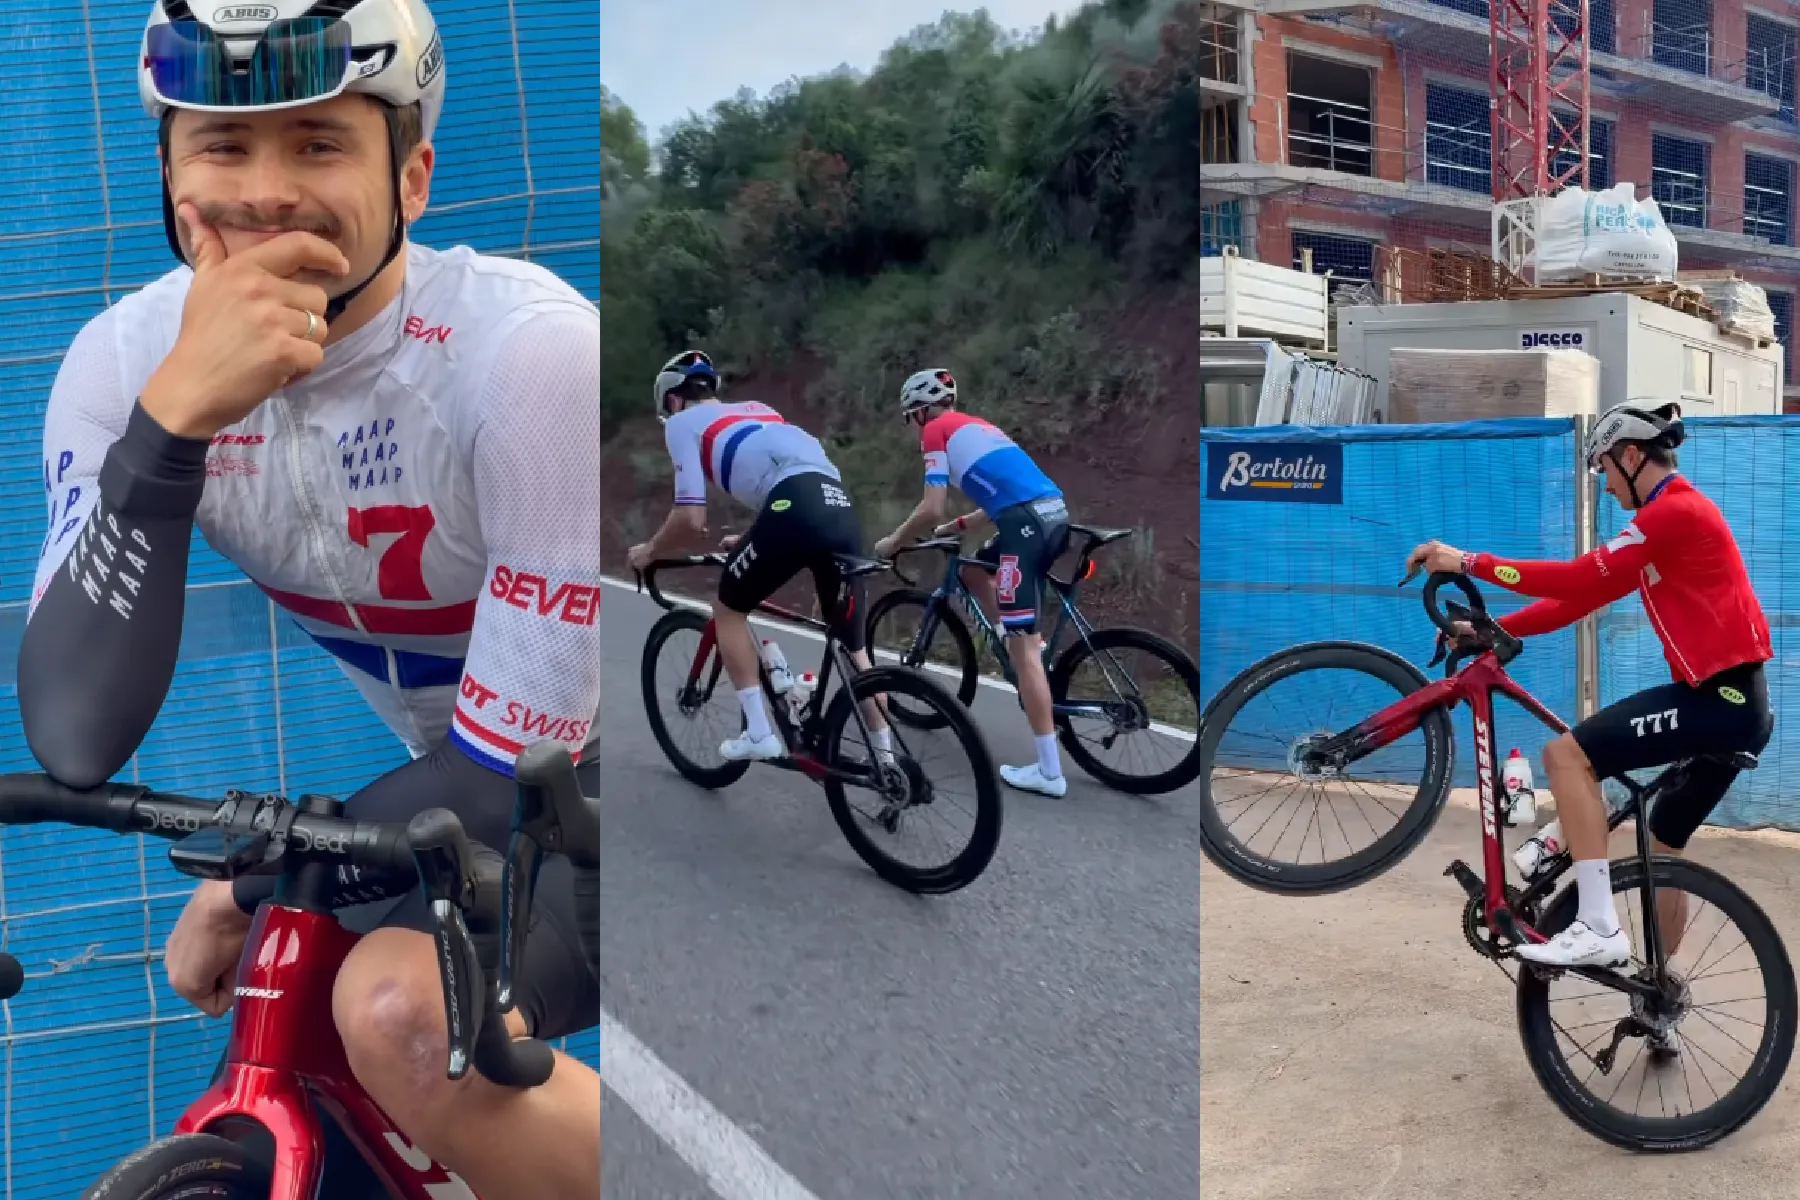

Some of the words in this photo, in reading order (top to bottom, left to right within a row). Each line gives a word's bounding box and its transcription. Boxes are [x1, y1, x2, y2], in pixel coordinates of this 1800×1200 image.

[221, 8, 271, 19] ABUS
[209, 434, 265, 446] VENS
[342, 442, 398, 469] MAAP
[349, 467, 403, 491] MAAP
[82, 513, 122, 604] MAAP
[347, 504, 435, 600] 7
[109, 528, 151, 620] MAAP
[461, 672, 499, 709] DT
[500, 702, 590, 741] SWISS
[1630, 708, 1679, 737] 777
[1475, 716, 1496, 841] STEVENS
[170, 1158, 207, 1178] ZERO
